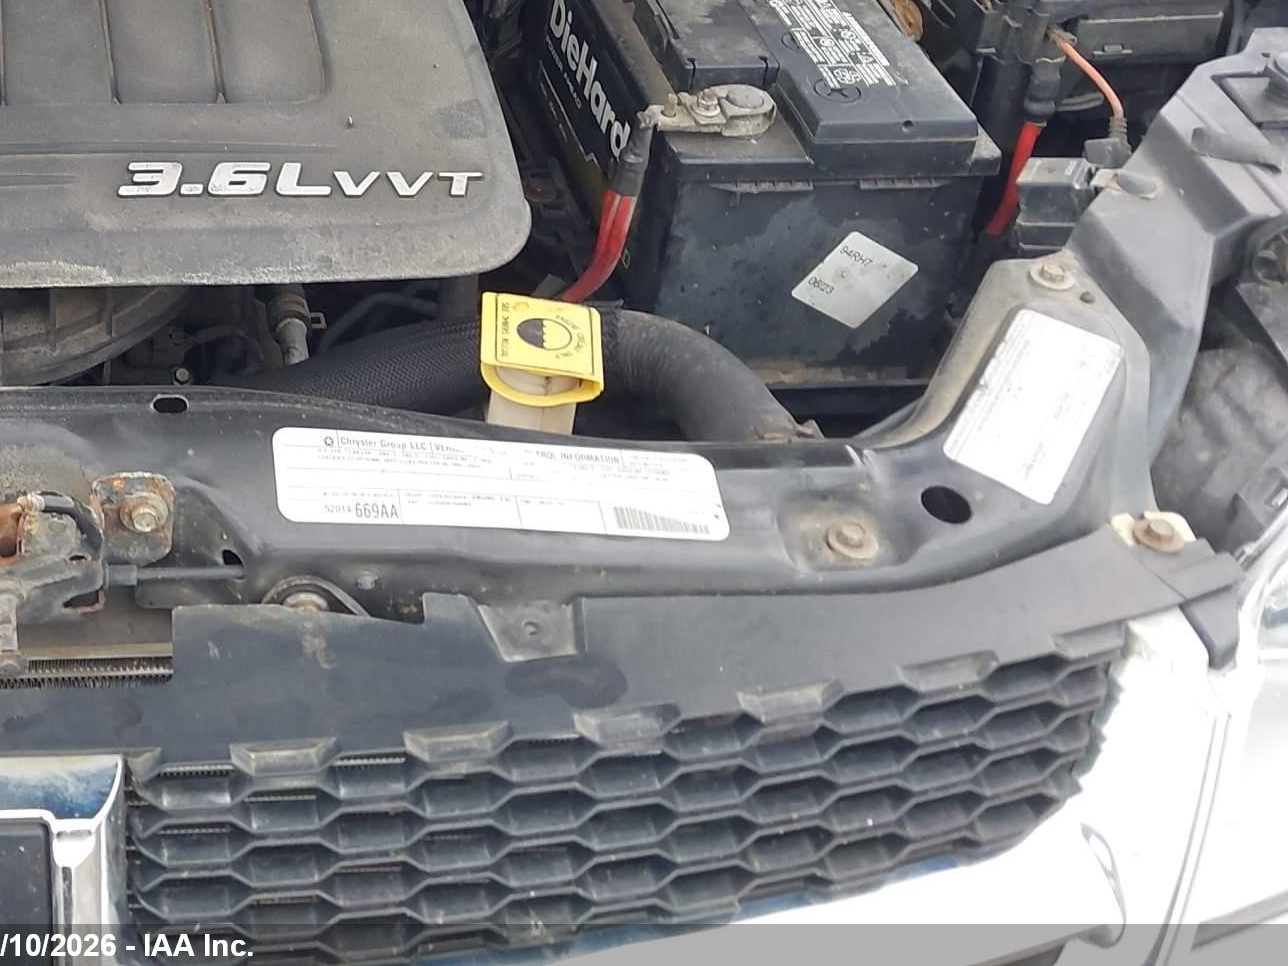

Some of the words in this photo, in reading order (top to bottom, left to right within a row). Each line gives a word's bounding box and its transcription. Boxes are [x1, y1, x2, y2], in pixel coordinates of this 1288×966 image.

[340, 436, 377, 448] Chrysler
[380, 439, 407, 451] Group
[410, 441, 427, 451] LLC
[559, 452, 620, 465] INFORMATION
[354, 502, 400, 520] 669AA
